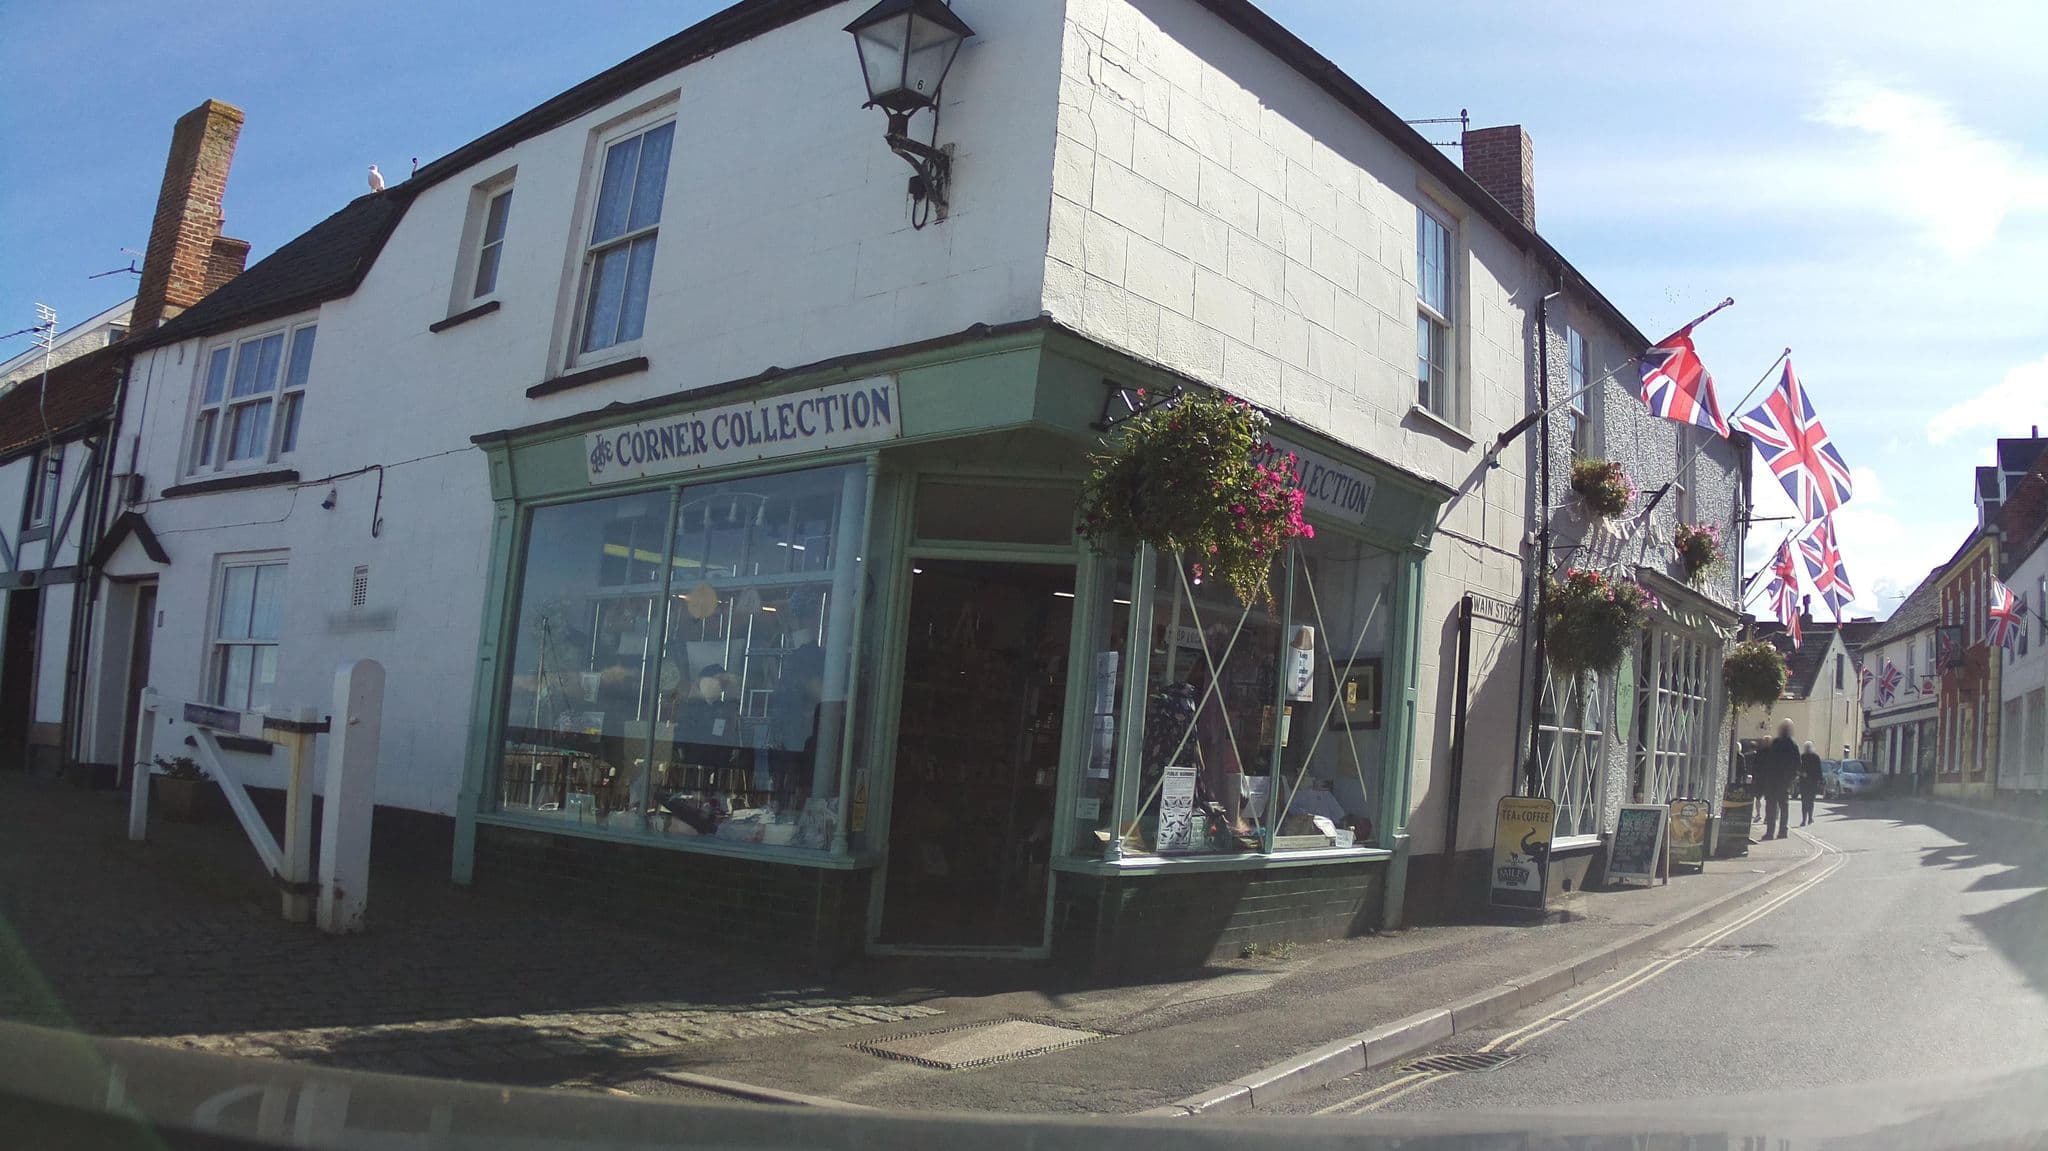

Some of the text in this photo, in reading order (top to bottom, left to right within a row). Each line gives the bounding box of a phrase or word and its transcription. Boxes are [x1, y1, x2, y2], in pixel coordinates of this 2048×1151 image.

[917, 79, 924, 90] 6
[616, 420, 708, 466] CORNER
[712, 385, 892, 450] COLLECTION
[1266, 448, 1372, 514] LECTION
[1502, 809, 1516, 821] TEA
[1521, 811, 1550, 823] COFFEE
